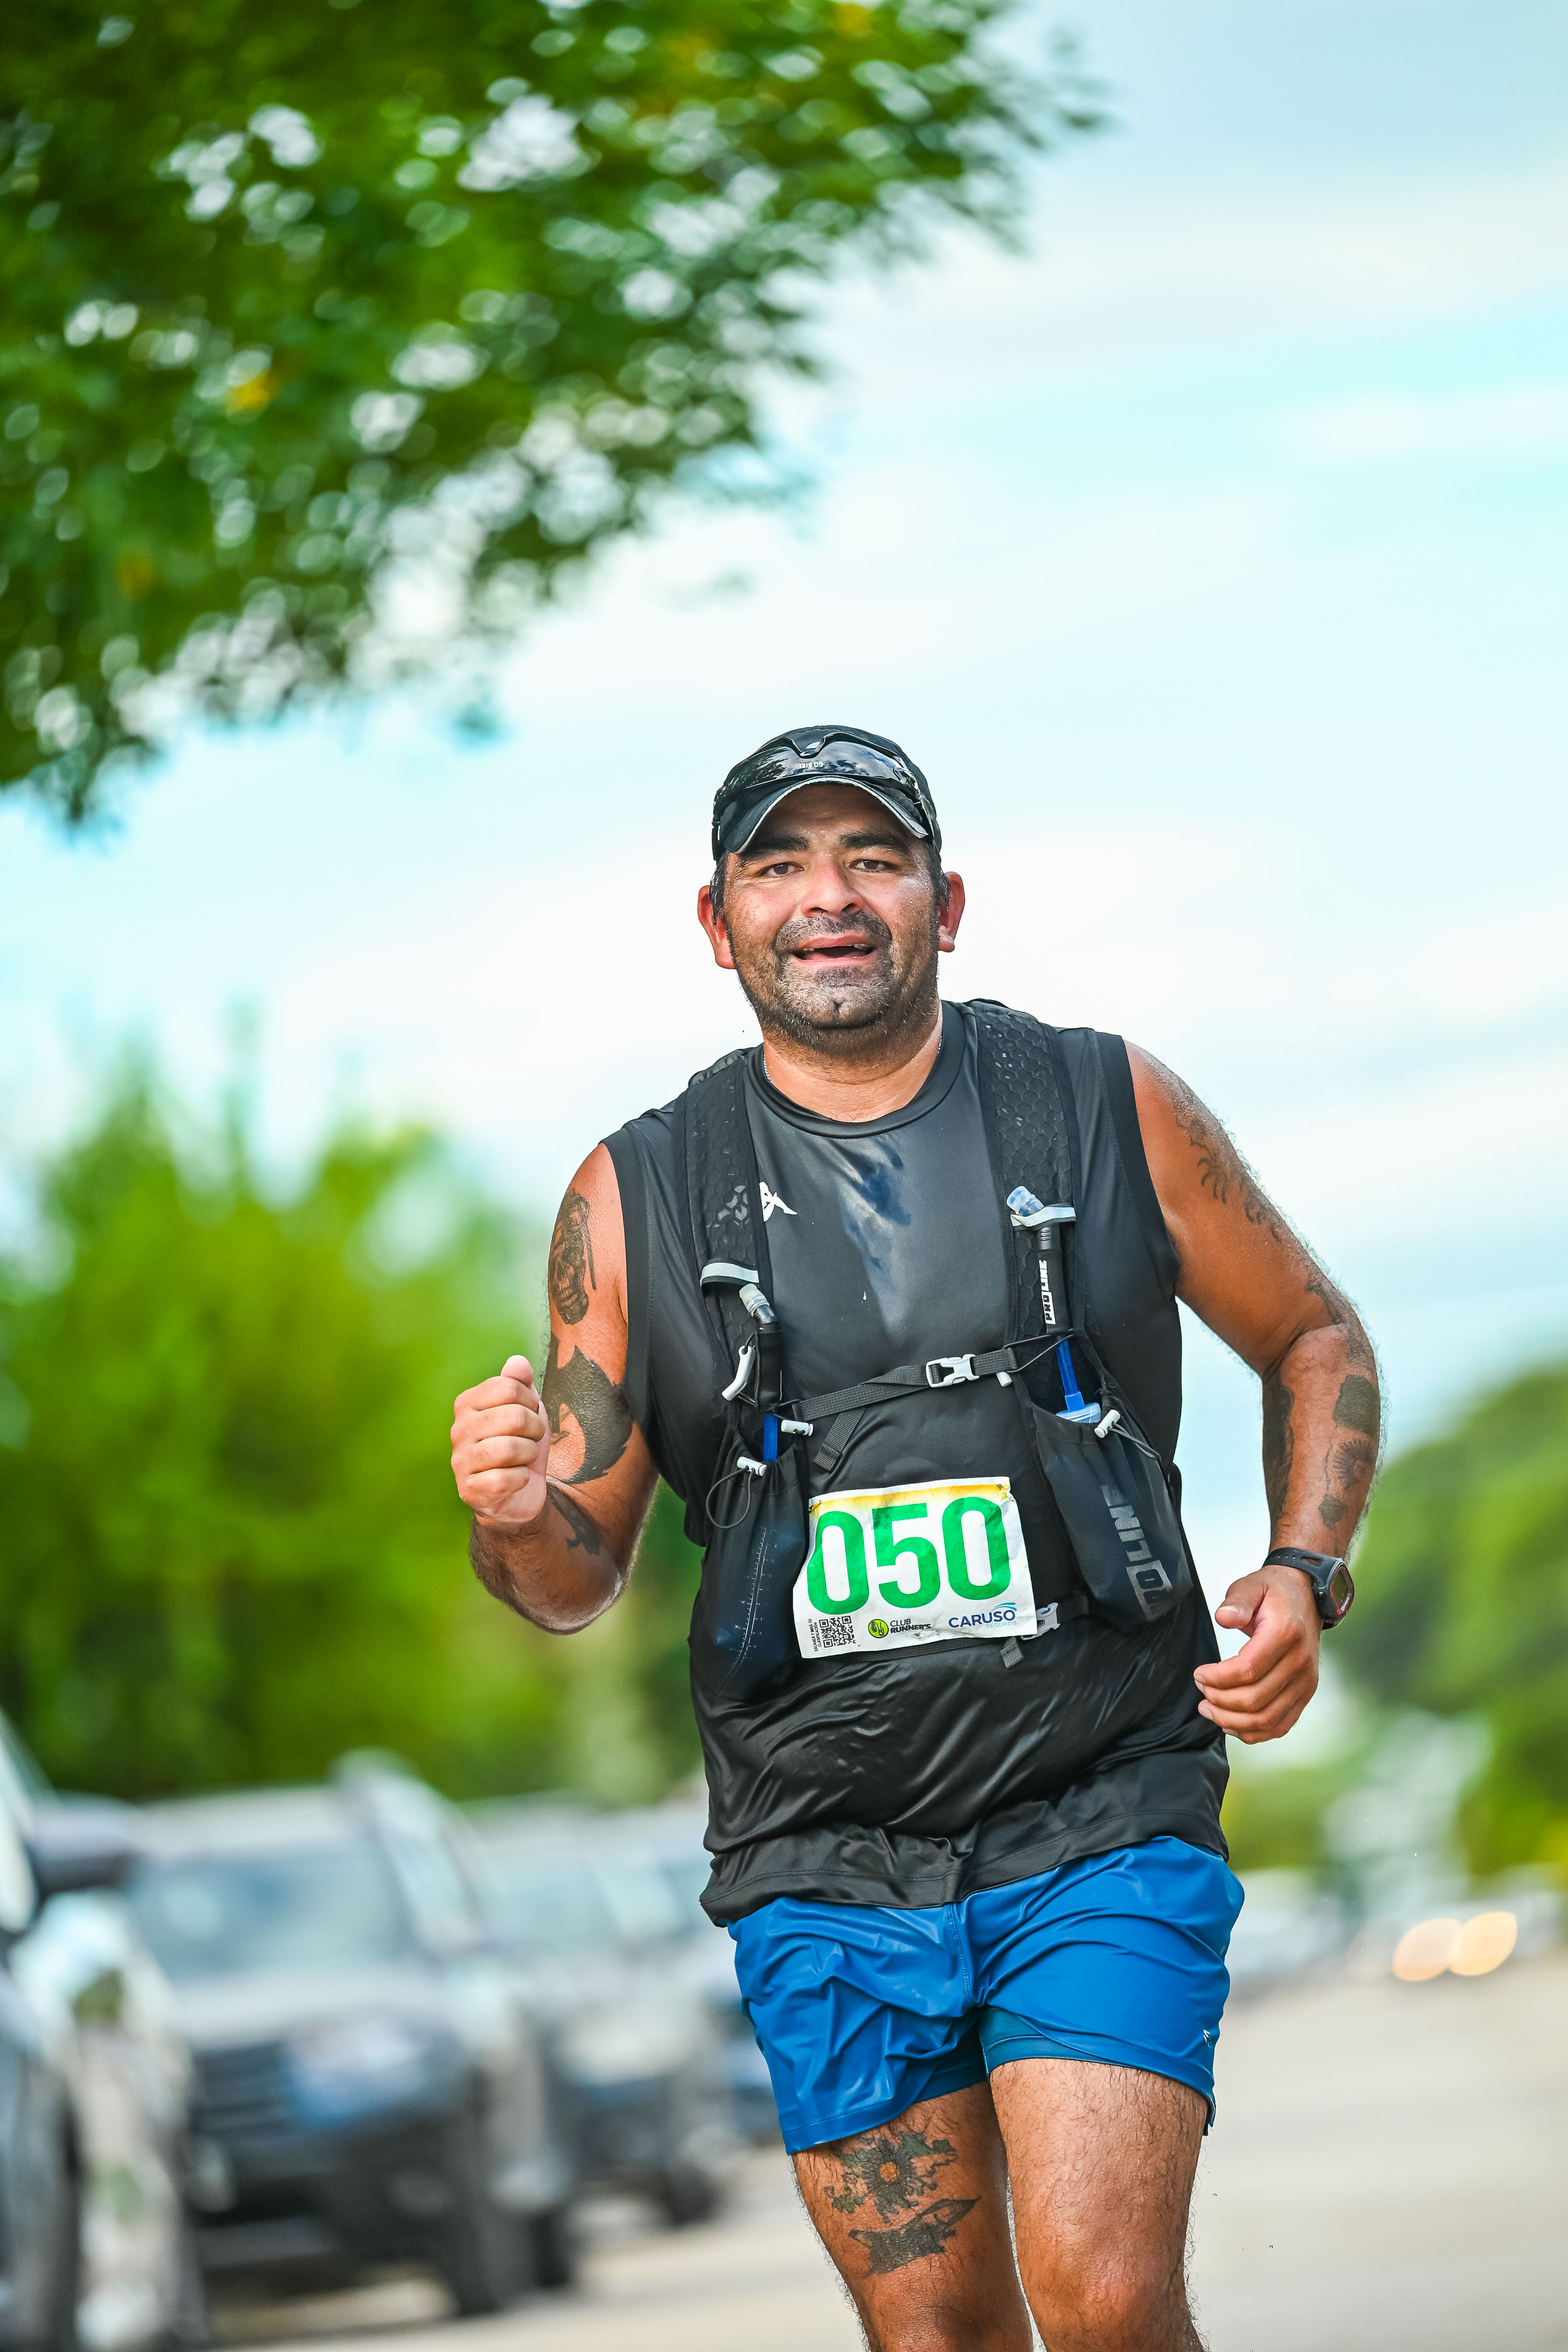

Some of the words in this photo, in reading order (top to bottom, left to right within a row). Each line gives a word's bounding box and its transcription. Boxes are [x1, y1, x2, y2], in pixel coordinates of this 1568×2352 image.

[806, 1496, 1012, 1615] 050
[890, 1619, 912, 1627] CLUB
[948, 1610, 1015, 1628] CARUSO
[890, 1624, 931, 1634] RUNNER'S
